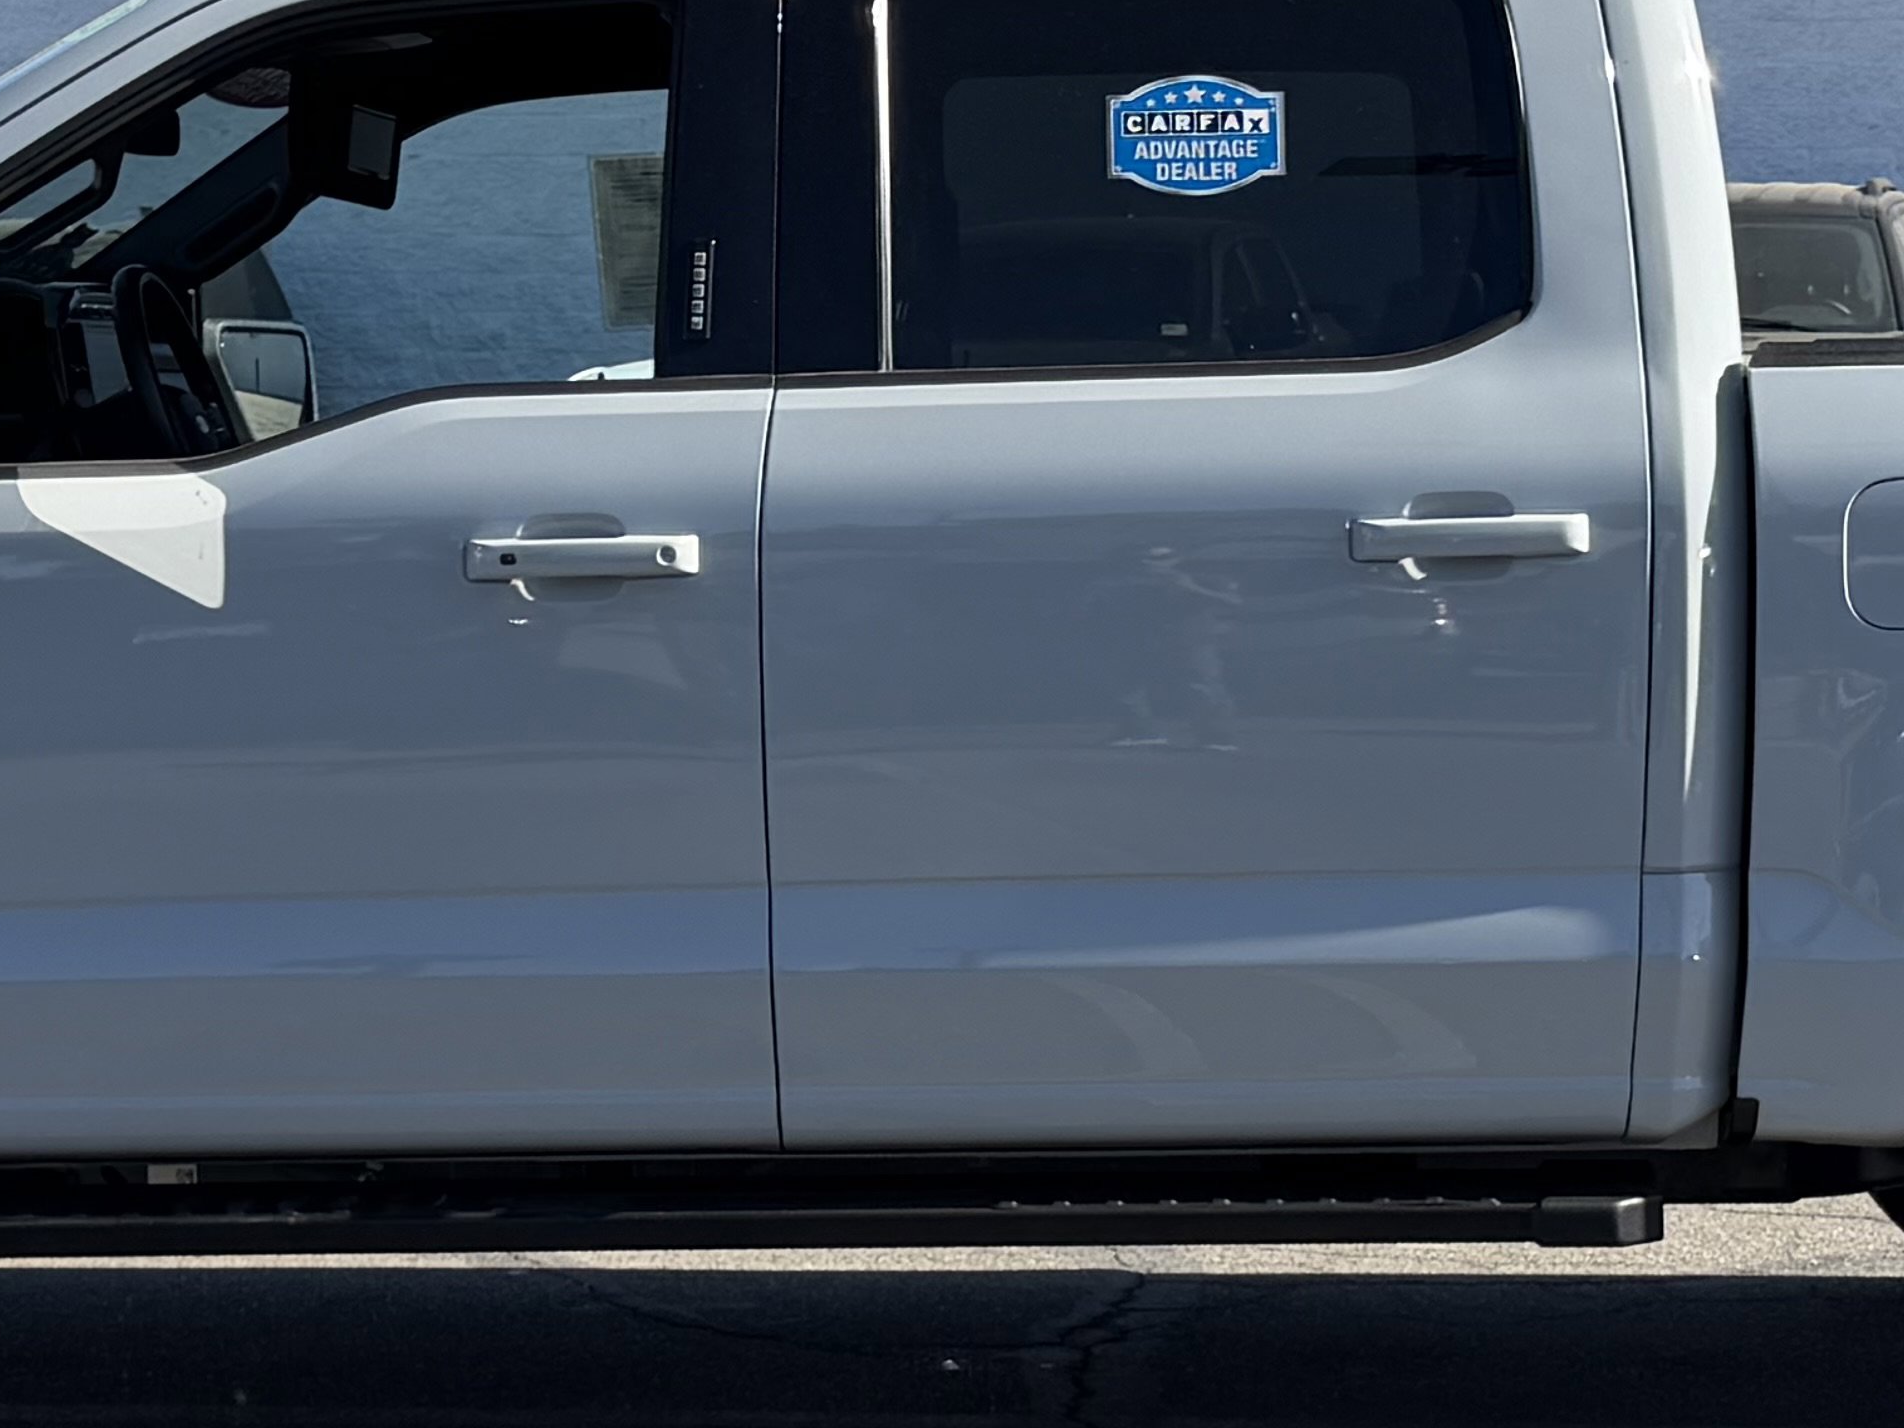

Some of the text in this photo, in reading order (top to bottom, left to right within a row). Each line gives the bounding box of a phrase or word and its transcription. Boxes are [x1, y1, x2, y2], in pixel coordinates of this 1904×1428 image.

[1124, 113, 1266, 134] CARFAX
[1134, 139, 1259, 160] ADVANTAGE
[1156, 161, 1238, 181] DEALER
